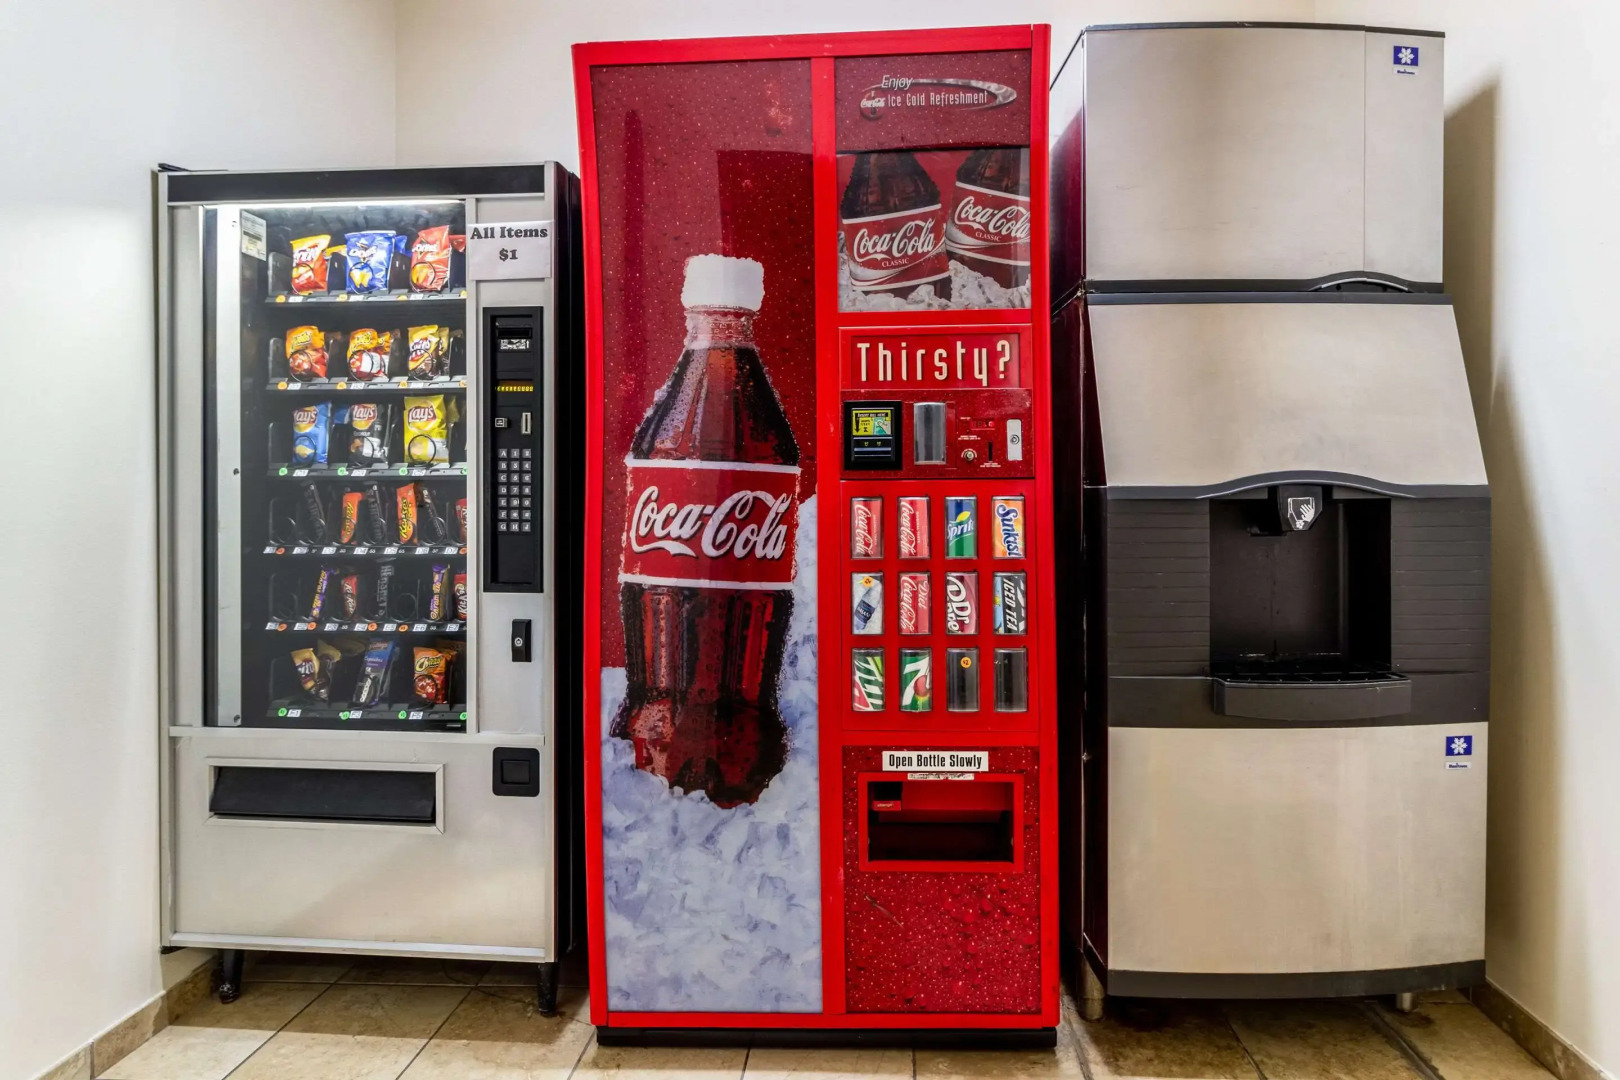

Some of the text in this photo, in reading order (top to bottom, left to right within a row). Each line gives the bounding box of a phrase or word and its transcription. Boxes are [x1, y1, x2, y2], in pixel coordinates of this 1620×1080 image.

[881, 74, 913, 91] Enjoy
[888, 91, 988, 107] Ice Cold Refreshment
[470, 226, 548, 240] All Items
[853, 218, 937, 263] Coca-Cola
[975, 231, 1002, 242] CLASSIC
[499, 247, 519, 262] $1
[881, 257, 910, 268] CLASSIC
[857, 339, 1011, 387] Thirsty?
[629, 485, 794, 560] Coca-Cola
[854, 504, 874, 555] Coca-Cola
[900, 501, 917, 556] Coca-Cola
[900, 576, 917, 633] Coca-Cola
[917, 580, 930, 609] Diet
[1003, 578, 1018, 632] ICED TEA
[951, 601, 971, 624] Dr
[888, 753, 982, 770] Open Bottle Slowly
